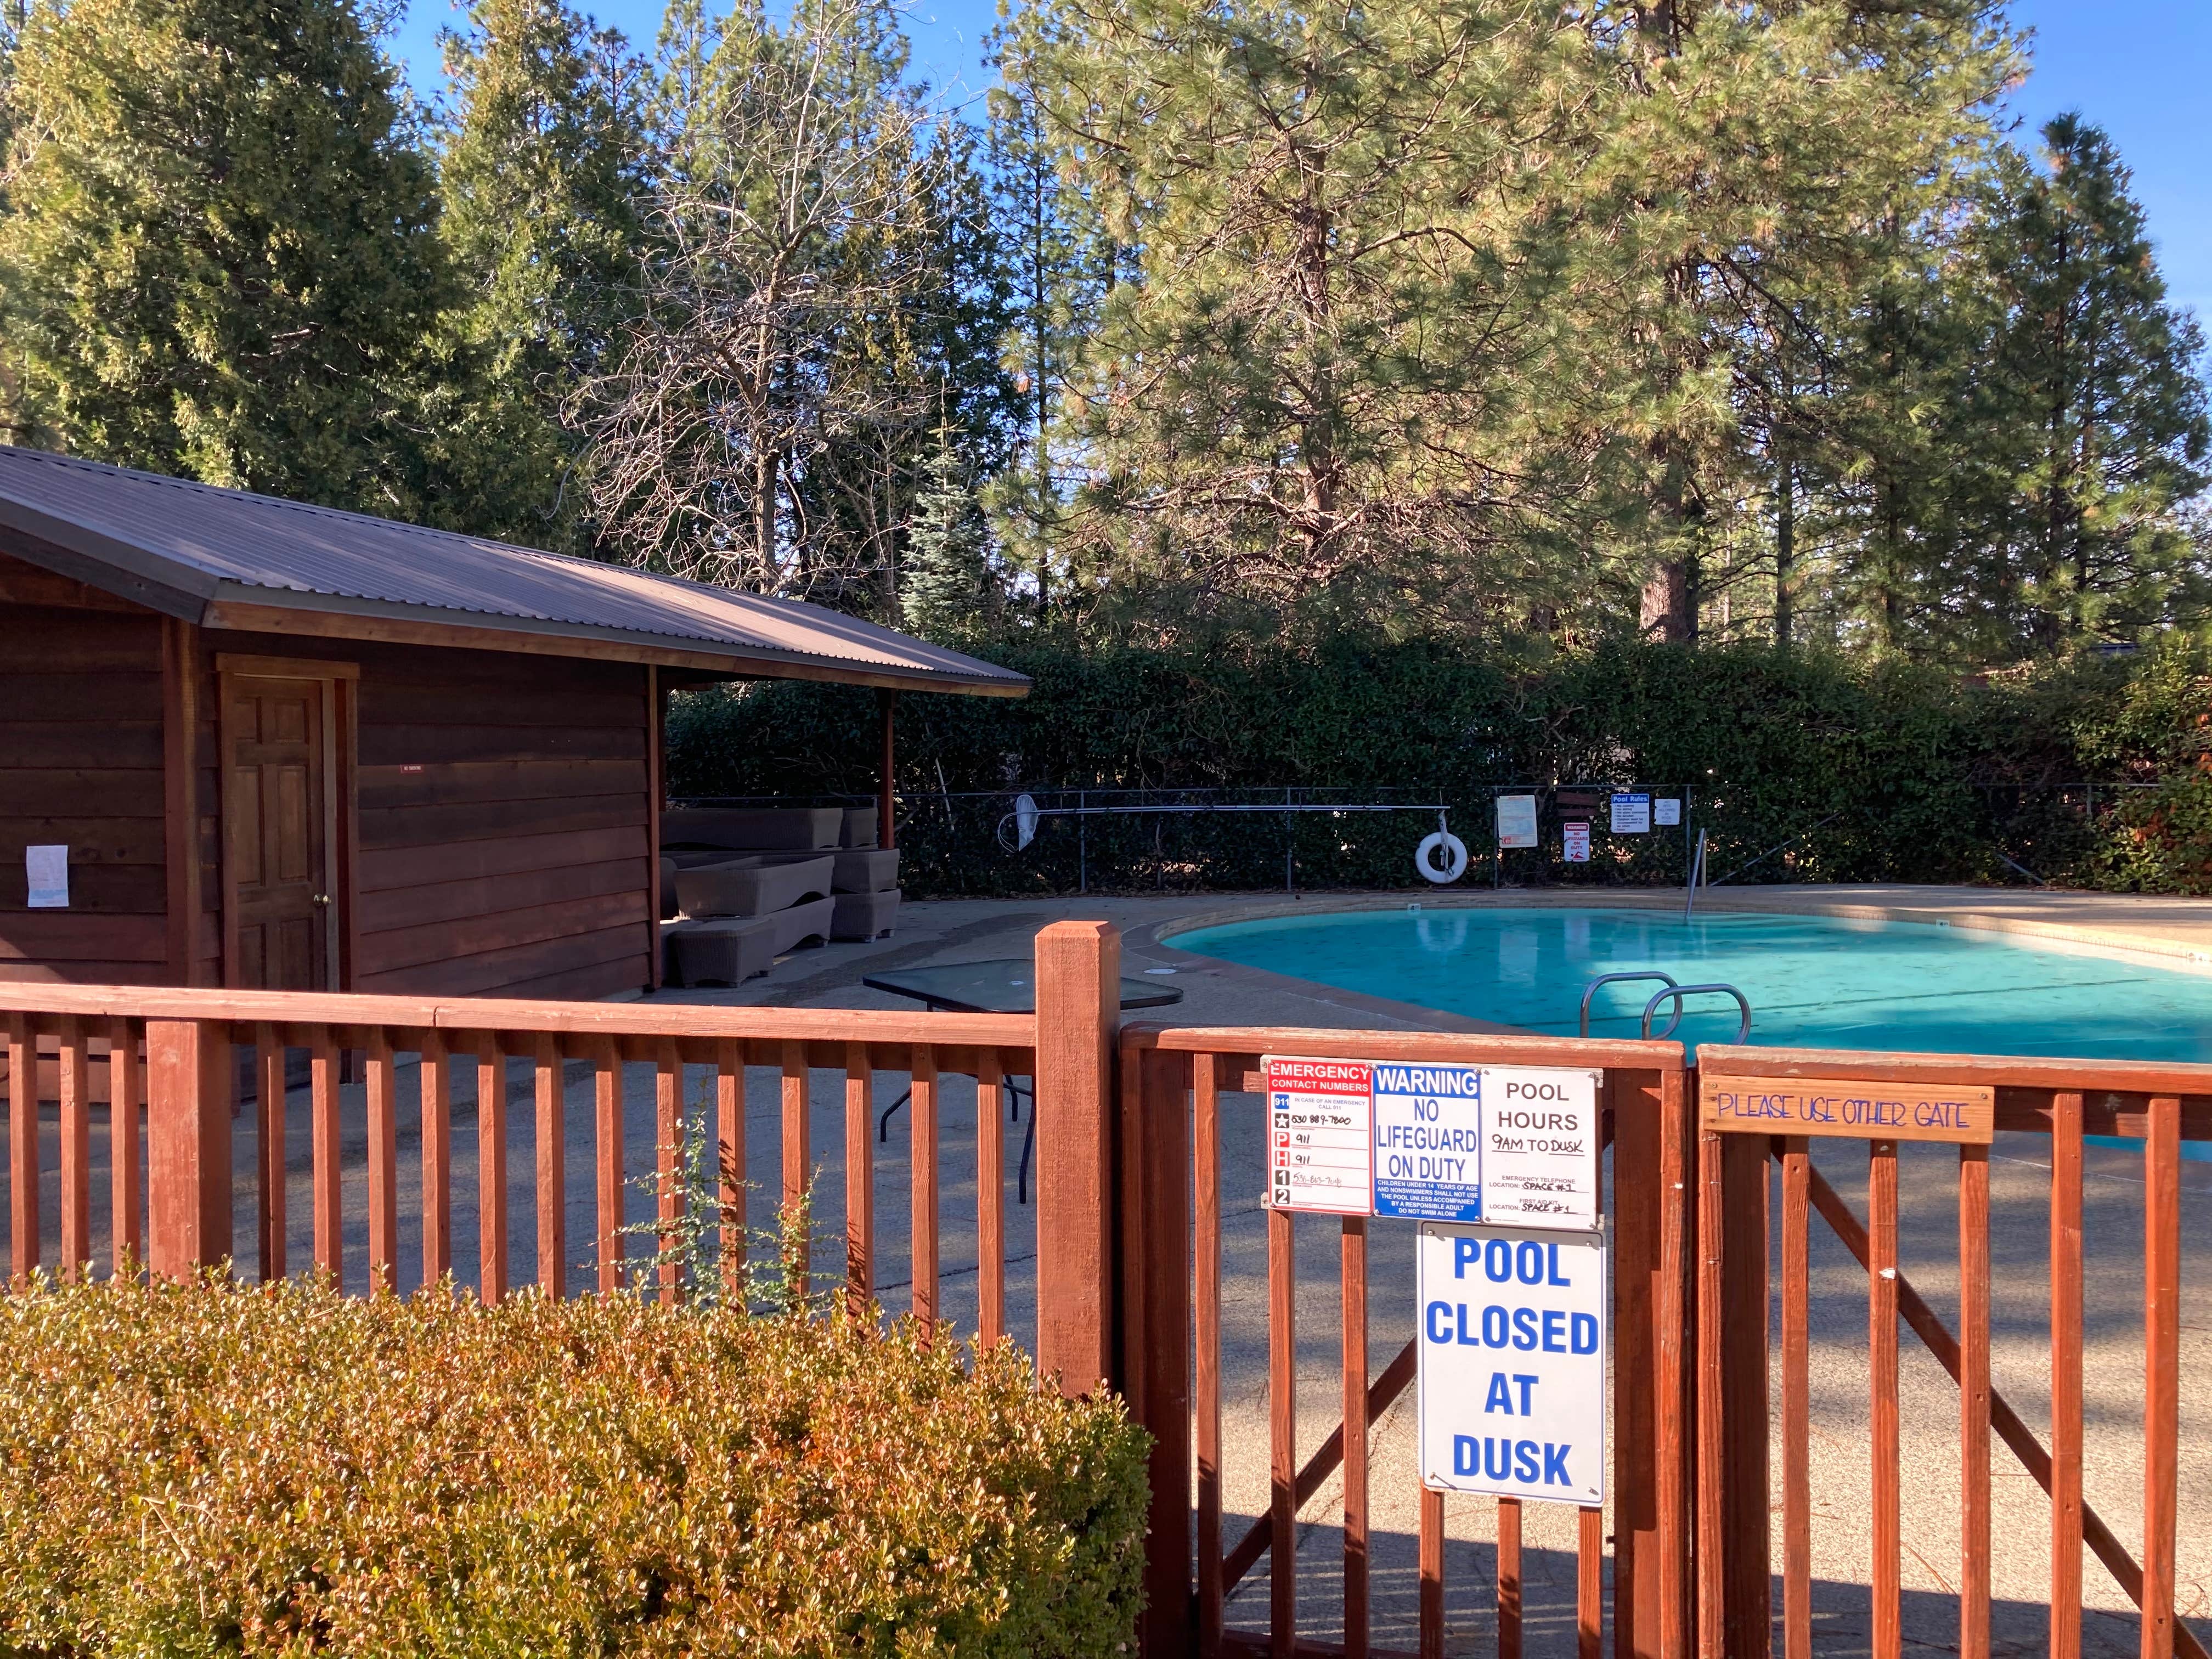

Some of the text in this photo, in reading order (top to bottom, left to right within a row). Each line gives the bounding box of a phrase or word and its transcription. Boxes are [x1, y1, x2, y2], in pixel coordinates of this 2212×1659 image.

[1270, 1063, 1370, 1080] EMERGENCY
[1272, 1079, 1369, 1092] CONTACT NUMBERS
[1376, 1068, 1477, 1096] WARNING
[1506, 1082, 1569, 1101] POOL
[1275, 1098, 1289, 1107] 911
[1414, 1098, 1439, 1121] NO
[1718, 1093, 1971, 1128] PLEASE USE OTHER GATE
[1291, 1115, 1307, 1124] 530
[1498, 1111, 1578, 1131] HOURS
[1277, 1133, 1288, 1147] P
[1296, 1134, 1310, 1144] 911
[1378, 1125, 1476, 1152] LIFEGUARD
[1492, 1134, 1584, 1153] 9AM TO DUSK
[1277, 1152, 1288, 1166] H
[1295, 1154, 1310, 1164] 911
[1389, 1155, 1465, 1181] ON DUTY
[1279, 1171, 1286, 1185] 1
[1522, 1182, 1554, 1191] SPACE
[1278, 1189, 1288, 1203] 2
[1405, 1201, 1447, 1210] RESPONSIBLE
[1522, 1203, 1551, 1212] SPACE
[1454, 1237, 1571, 1287] POOL
[1426, 1301, 1599, 1355] CLOSED
[1484, 1372, 1539, 1417] AT
[1453, 1434, 1573, 1487] DUSK
